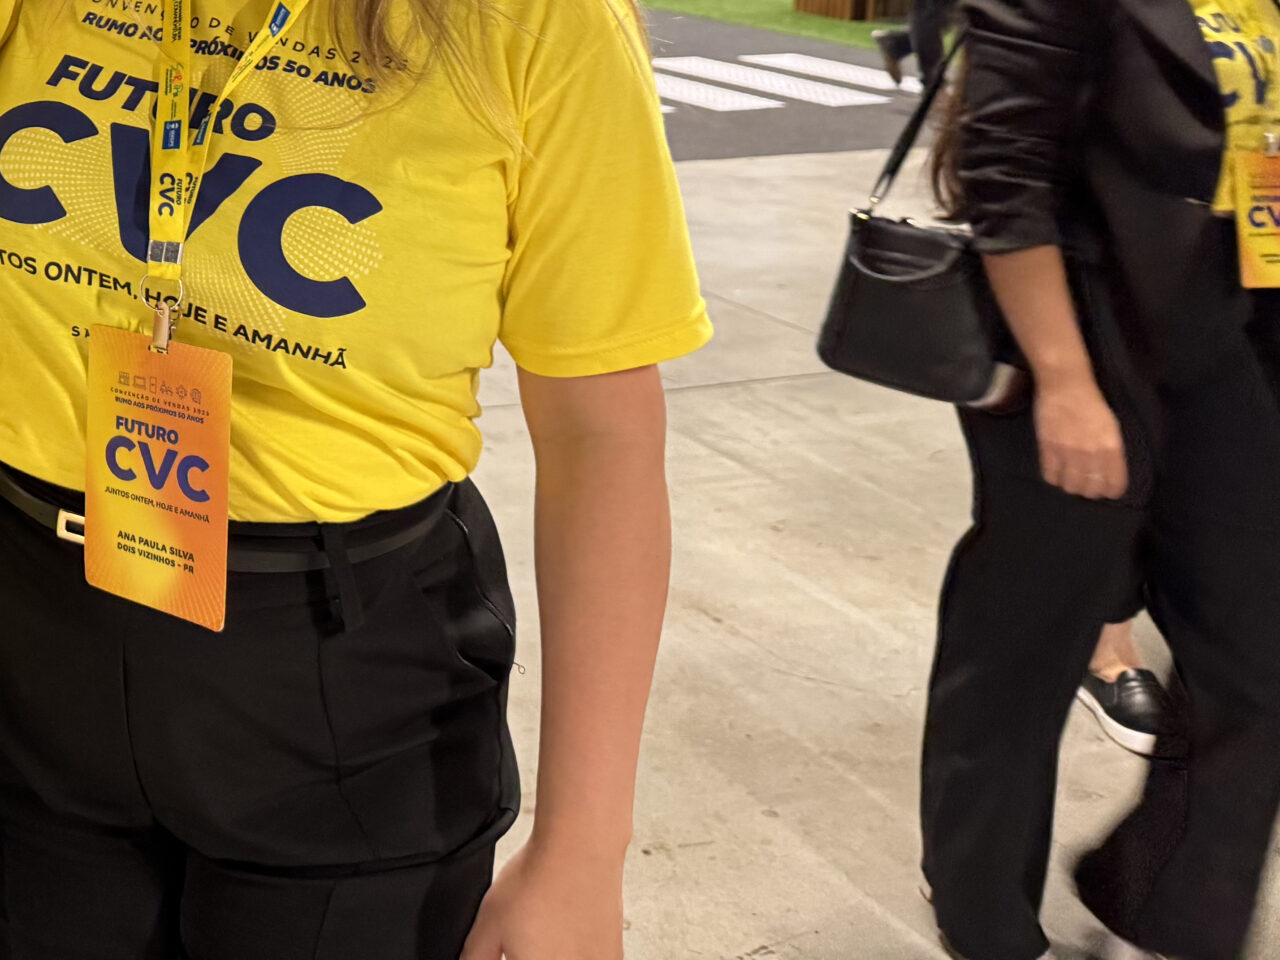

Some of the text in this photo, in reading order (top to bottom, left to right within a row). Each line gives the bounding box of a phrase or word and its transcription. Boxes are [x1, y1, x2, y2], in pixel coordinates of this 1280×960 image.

[81, 11, 139, 37] RUMO
[139, 25, 164, 42] AO
[190, 36, 281, 71] PRÓXIOS
[282, 59, 311, 78] 50
[313, 70, 376, 94] ANOS
[209, 17, 235, 36] DE
[248, 31, 337, 60] VNDAS
[351, 50, 409, 72] 225
[158, 173, 176, 217] CVC
[1248, 205, 1280, 228] CV
[44, 261, 138, 300] ONTEM,
[213, 313, 228, 333] E
[233, 324, 348, 369] AMANHÃ
[115, 396, 132, 406] RUMO
[133, 400, 145, 409] AOS
[146, 402, 177, 417] PRÓXIMOS
[186, 413, 204, 424] ANOS
[163, 399, 190, 411] VENDAS
[115, 415, 179, 445] FUTURO
[105, 435, 211, 503] CVC
[104, 485, 130, 499] JUNTOS
[131, 493, 155, 507] ONTEM,
[156, 500, 173, 513] HOJE
[179, 508, 210, 524] AMANHÃ
[117, 530, 195, 563] ANA PAULA SILVA
[117, 542, 136, 555] DOIS
[137, 548, 176, 568] VIZINHOS
[183, 564, 194, 574] PR
